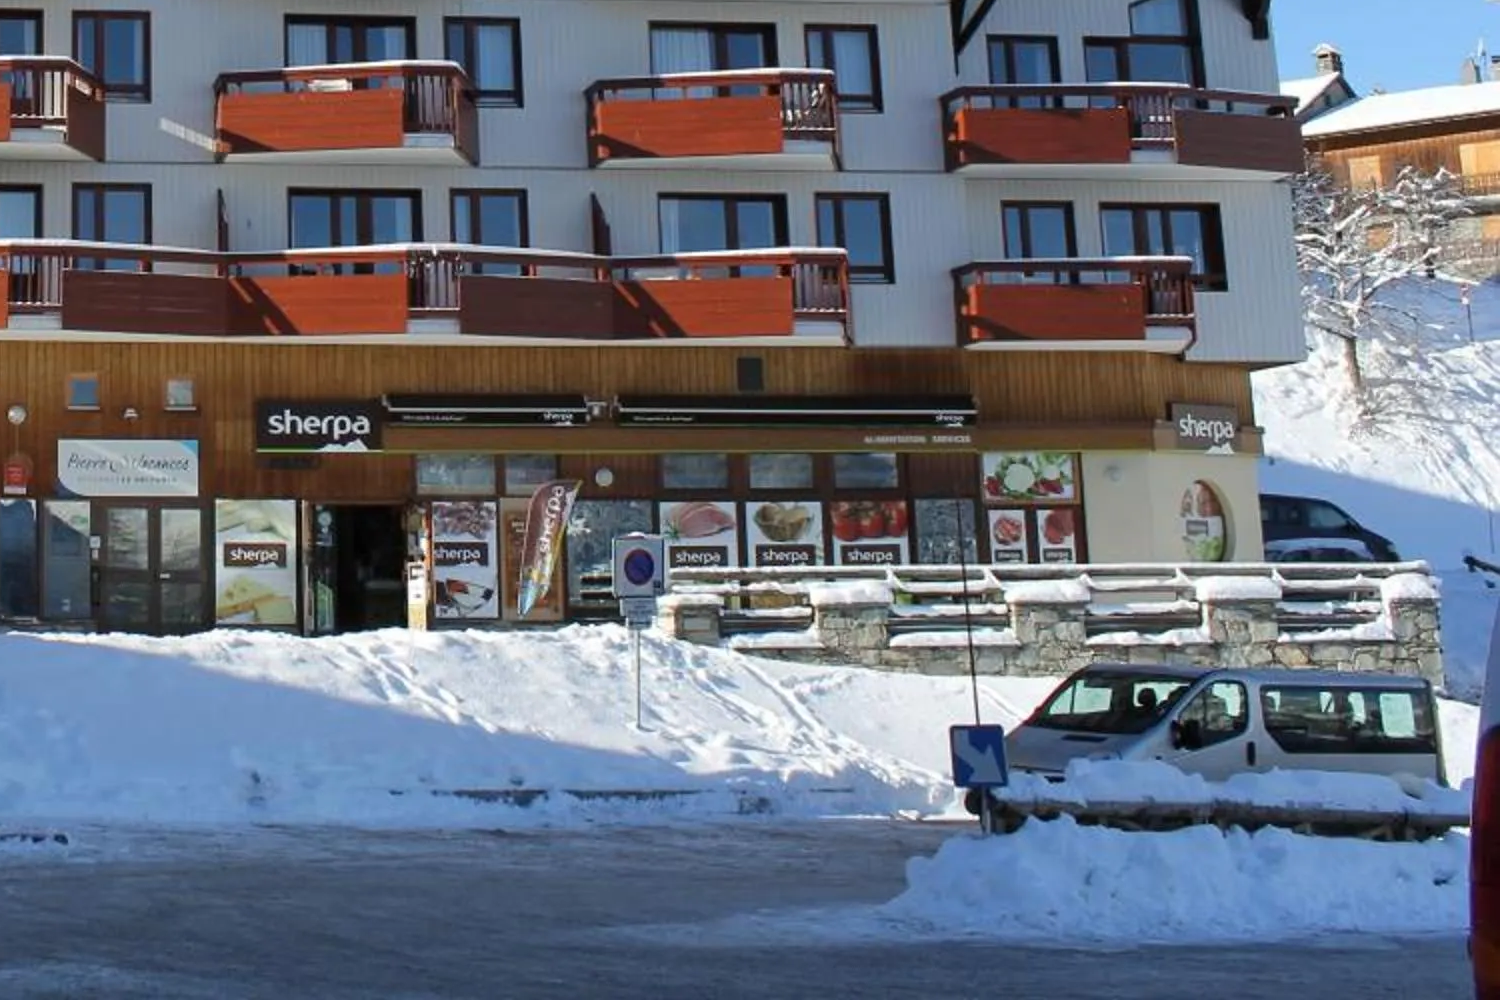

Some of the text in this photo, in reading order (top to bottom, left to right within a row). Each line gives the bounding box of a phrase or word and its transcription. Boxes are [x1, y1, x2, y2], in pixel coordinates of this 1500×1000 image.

[268, 409, 370, 440] sherpa
[1179, 413, 1235, 443] sherpa
[539, 485, 565, 554] sherpa
[230, 547, 279, 563] sherpa
[434, 546, 481, 561] sherpa
[675, 550, 721, 564] sherpa
[762, 549, 809, 562] sherpa
[847, 548, 894, 562] sherpa
